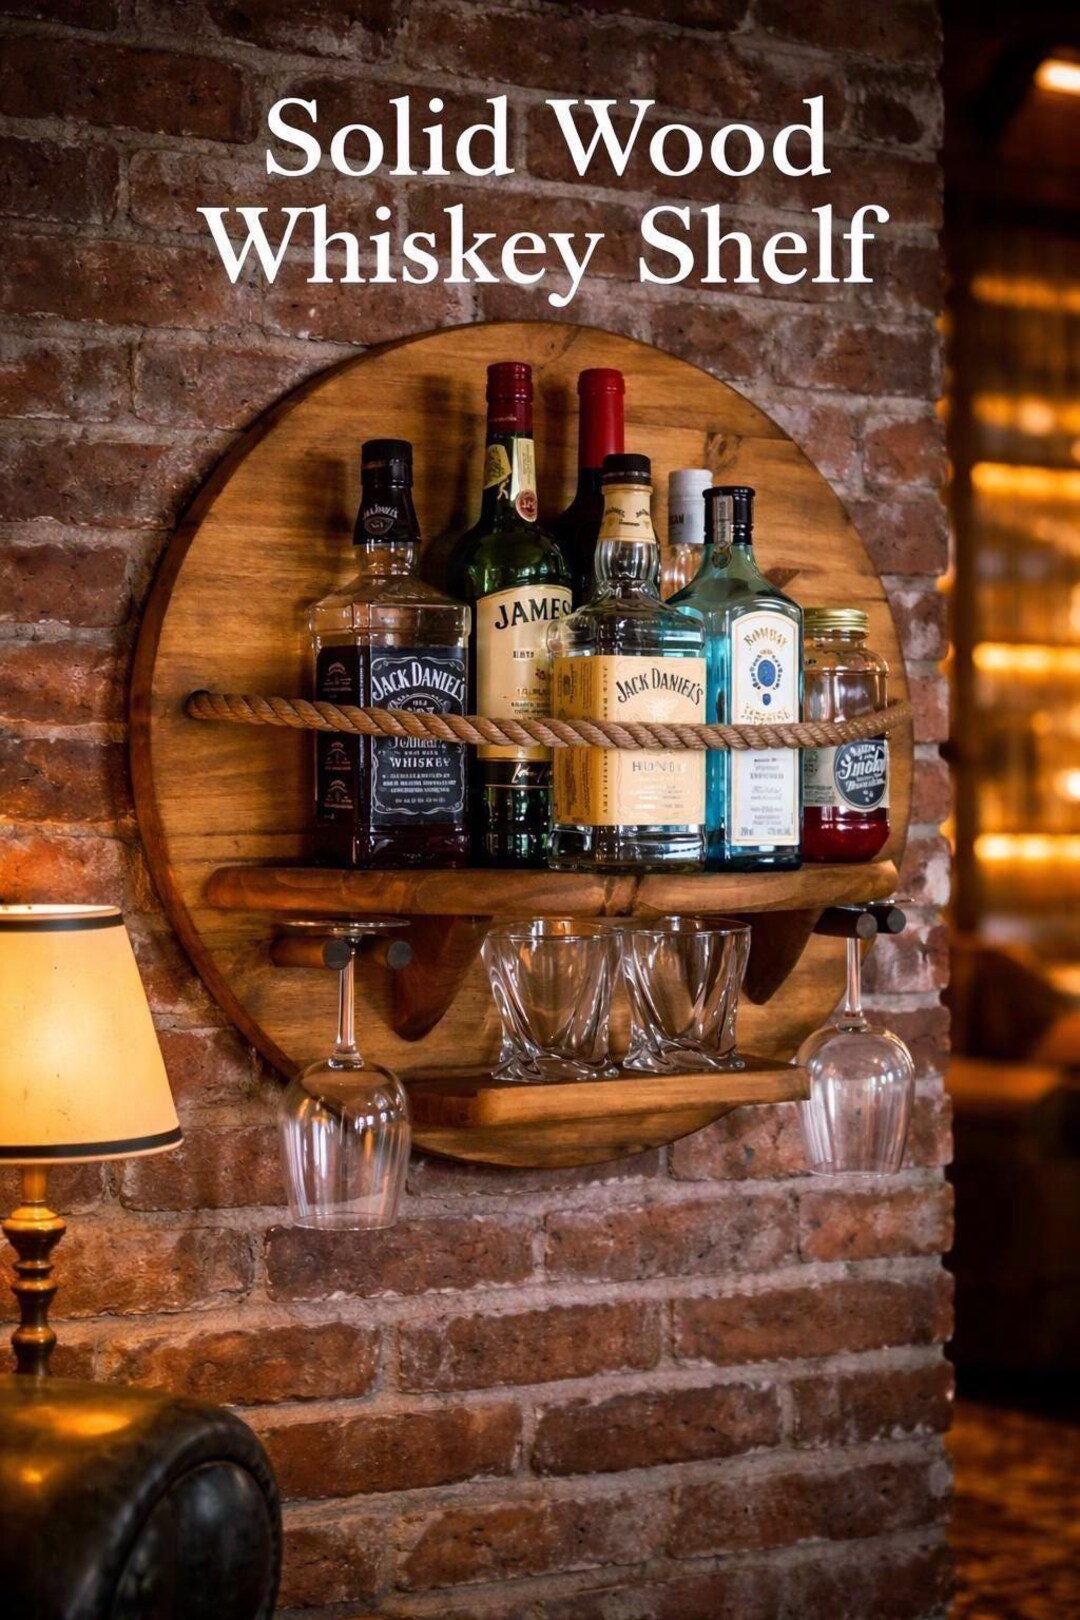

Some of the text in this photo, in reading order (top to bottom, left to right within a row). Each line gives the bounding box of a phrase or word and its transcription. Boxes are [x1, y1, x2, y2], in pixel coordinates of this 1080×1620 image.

[371, 668, 411, 701] JACK
[411, 661, 468, 701] DANIEL'S
[615, 672, 649, 704] JACK
[651, 667, 704, 706] DANIEL'S
[389, 756, 451, 768] WHISKEY
